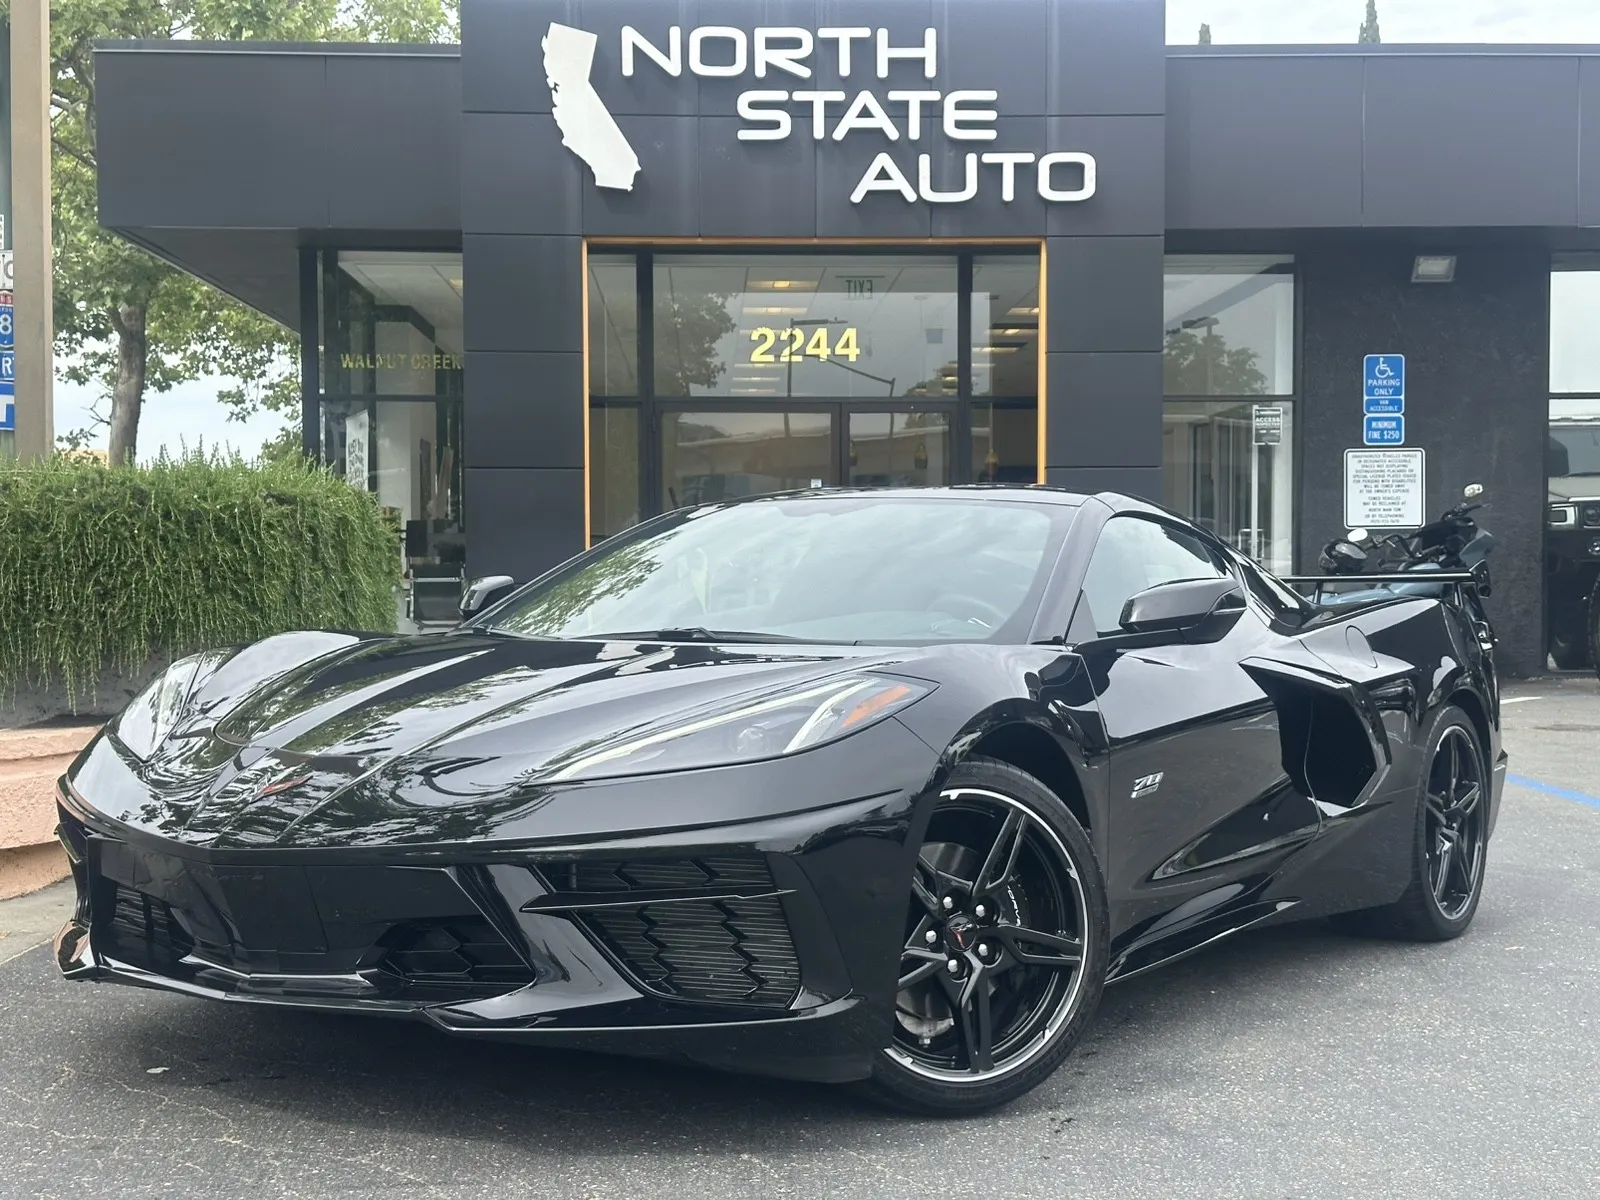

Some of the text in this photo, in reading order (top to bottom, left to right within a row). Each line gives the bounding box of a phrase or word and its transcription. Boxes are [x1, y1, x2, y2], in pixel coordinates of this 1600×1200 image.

[621, 25, 937, 79] NORTH
[737, 89, 998, 141] STATE
[850, 152, 1097, 203] AUTO
[340, 353, 463, 370] WALNUT CREEK
[749, 326, 860, 363] 2244
[1368, 430, 1400, 439] FINE $250
